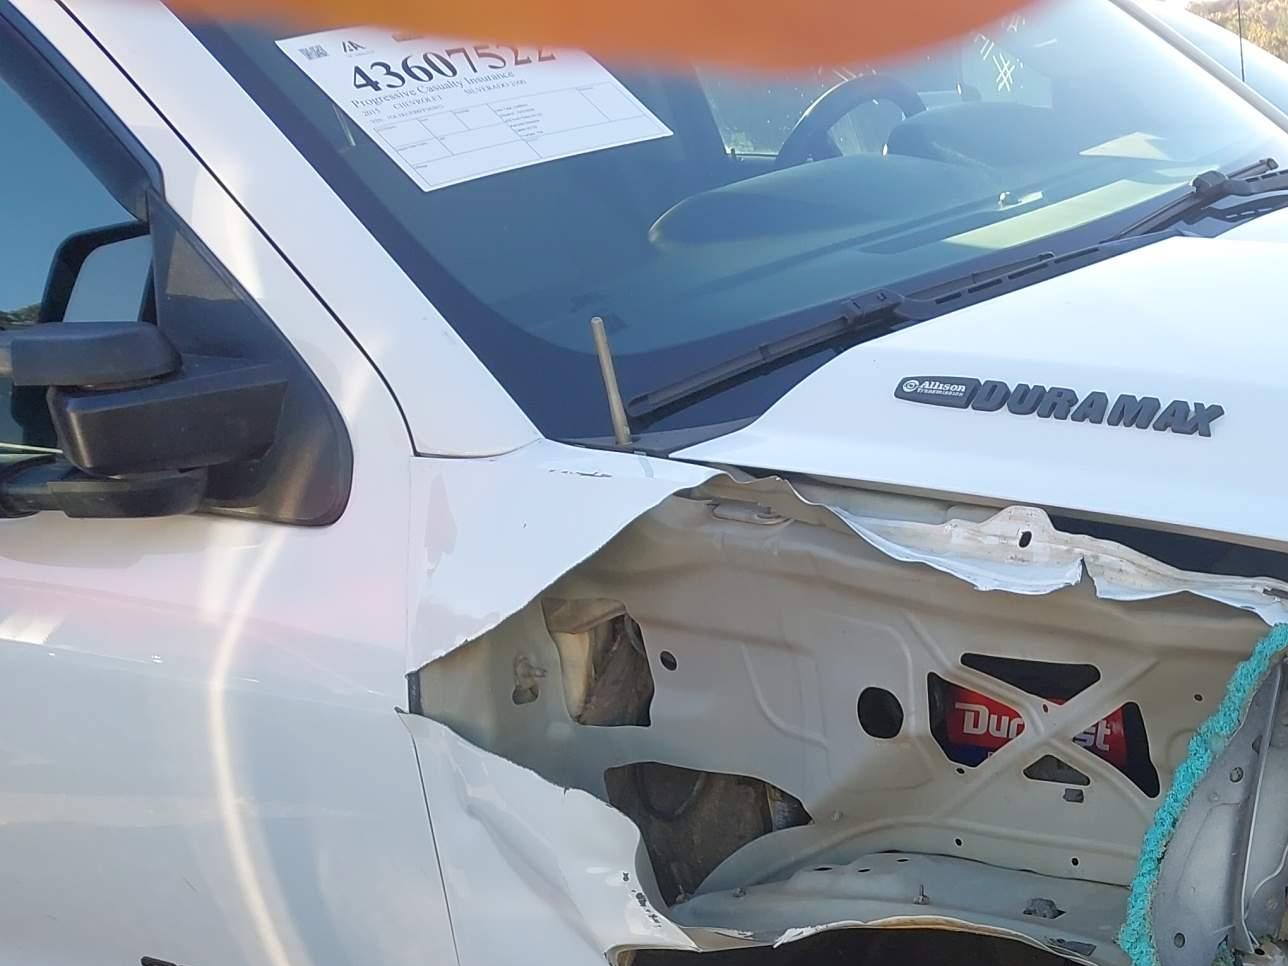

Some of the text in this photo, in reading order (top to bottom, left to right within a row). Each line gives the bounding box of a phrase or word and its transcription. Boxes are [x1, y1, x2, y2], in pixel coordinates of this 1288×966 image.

[351, 71, 515, 108] Progressive Casualty Insurance
[919, 380, 966, 392] Allison
[971, 379, 1225, 437] DURAMAX
